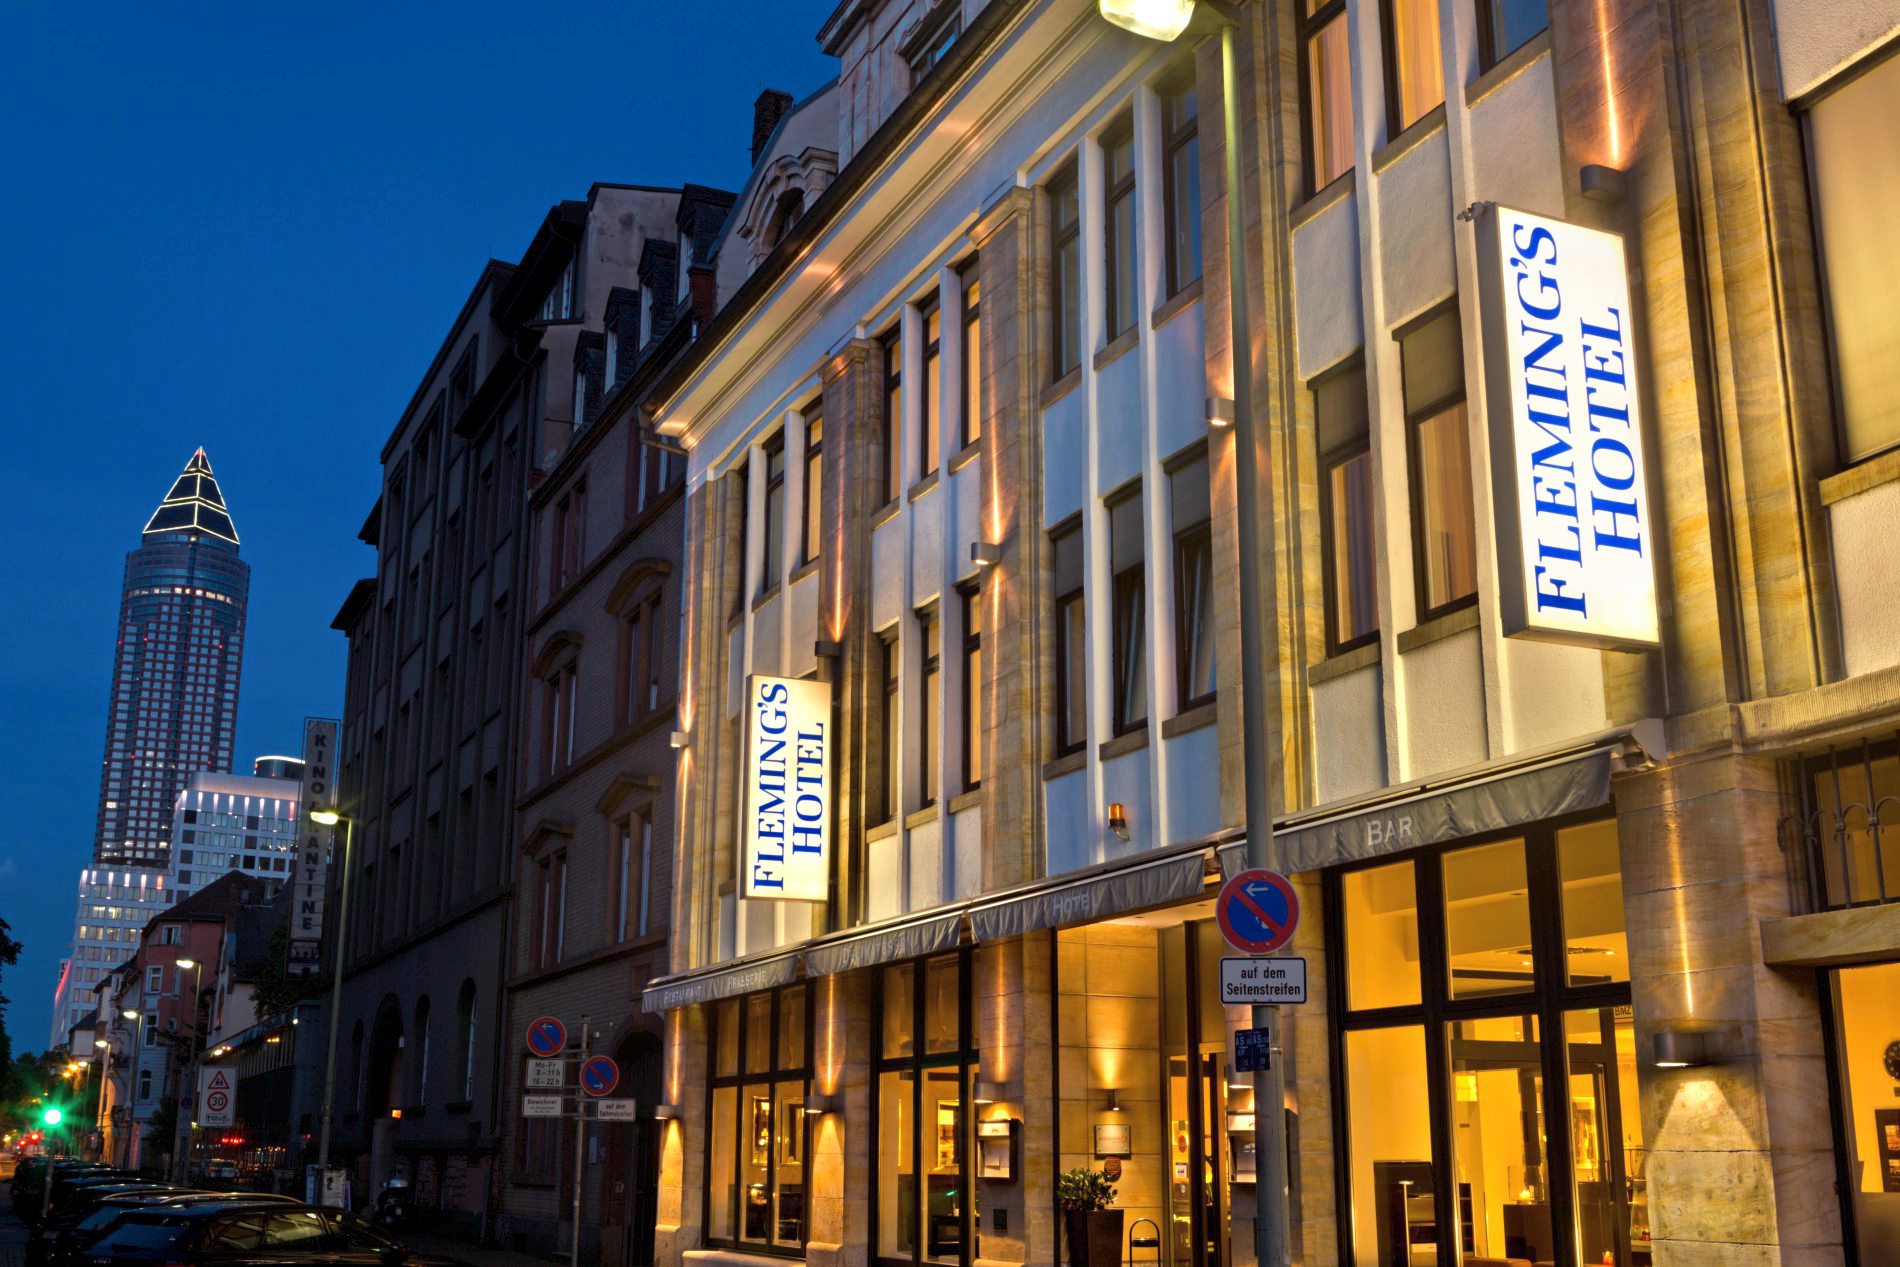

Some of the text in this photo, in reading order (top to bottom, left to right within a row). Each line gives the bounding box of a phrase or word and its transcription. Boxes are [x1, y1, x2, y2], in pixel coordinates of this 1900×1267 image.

[1510, 223, 1588, 620] FLEMING'S
[1580, 306, 1643, 559] HOTEL
[310, 734, 327, 795] KINO
[754, 683, 788, 891] FLEMING'S
[792, 722, 824, 857] HOTEL
[1367, 816, 1412, 846] BAR
[1052, 890, 1099, 917] HOTEL
[1226, 982, 1301, 996] Seitenstreifen
[1240, 966, 1286, 979] auf dem
[211, 1096, 224, 1106] 30
